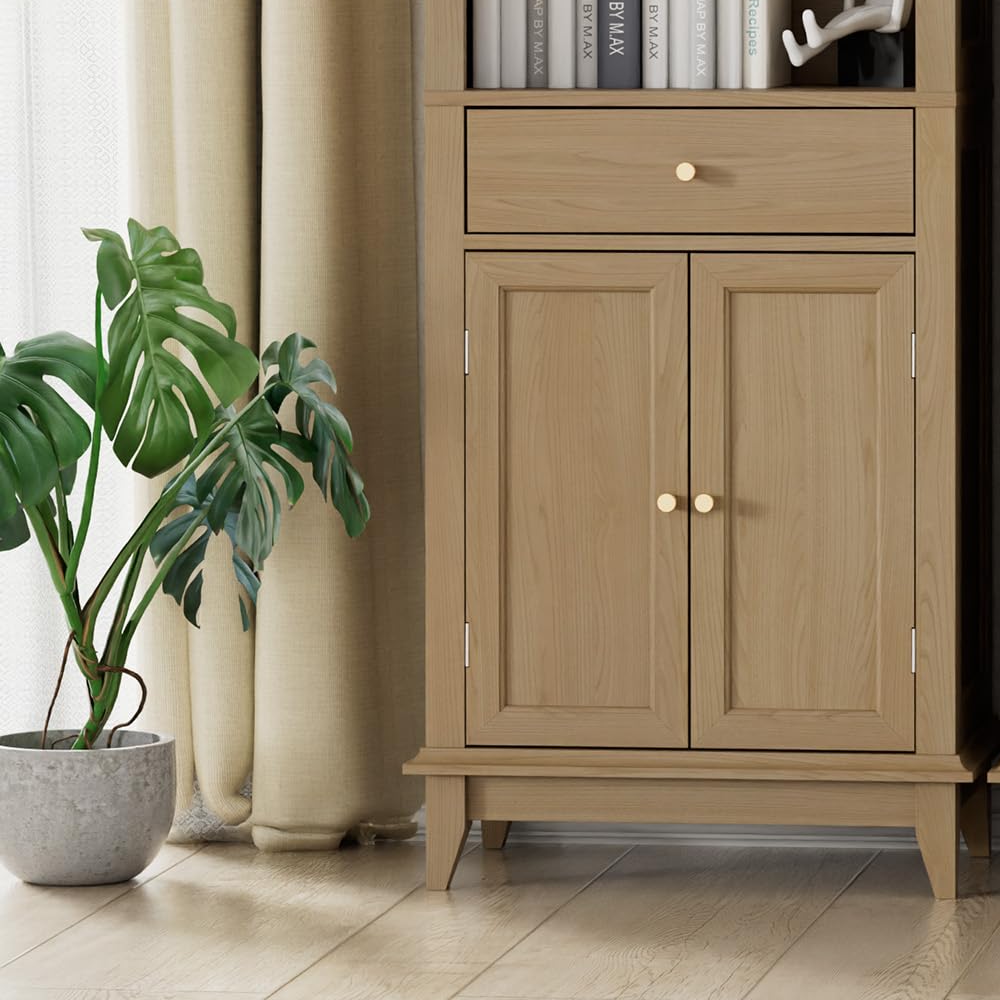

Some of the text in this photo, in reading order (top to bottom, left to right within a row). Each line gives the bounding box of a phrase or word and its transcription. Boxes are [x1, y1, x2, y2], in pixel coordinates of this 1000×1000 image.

[583, 4, 593, 22] BY
[609, 1, 624, 20] BY
[648, 5, 658, 22] BY
[533, 20, 544, 38] BY
[696, 23, 706, 40] BY
[583, 26, 593, 60] M.AX
[609, 23, 624, 56] M.AX
[648, 26, 658, 60] M.AX
[533, 41, 544, 75] M.AX
